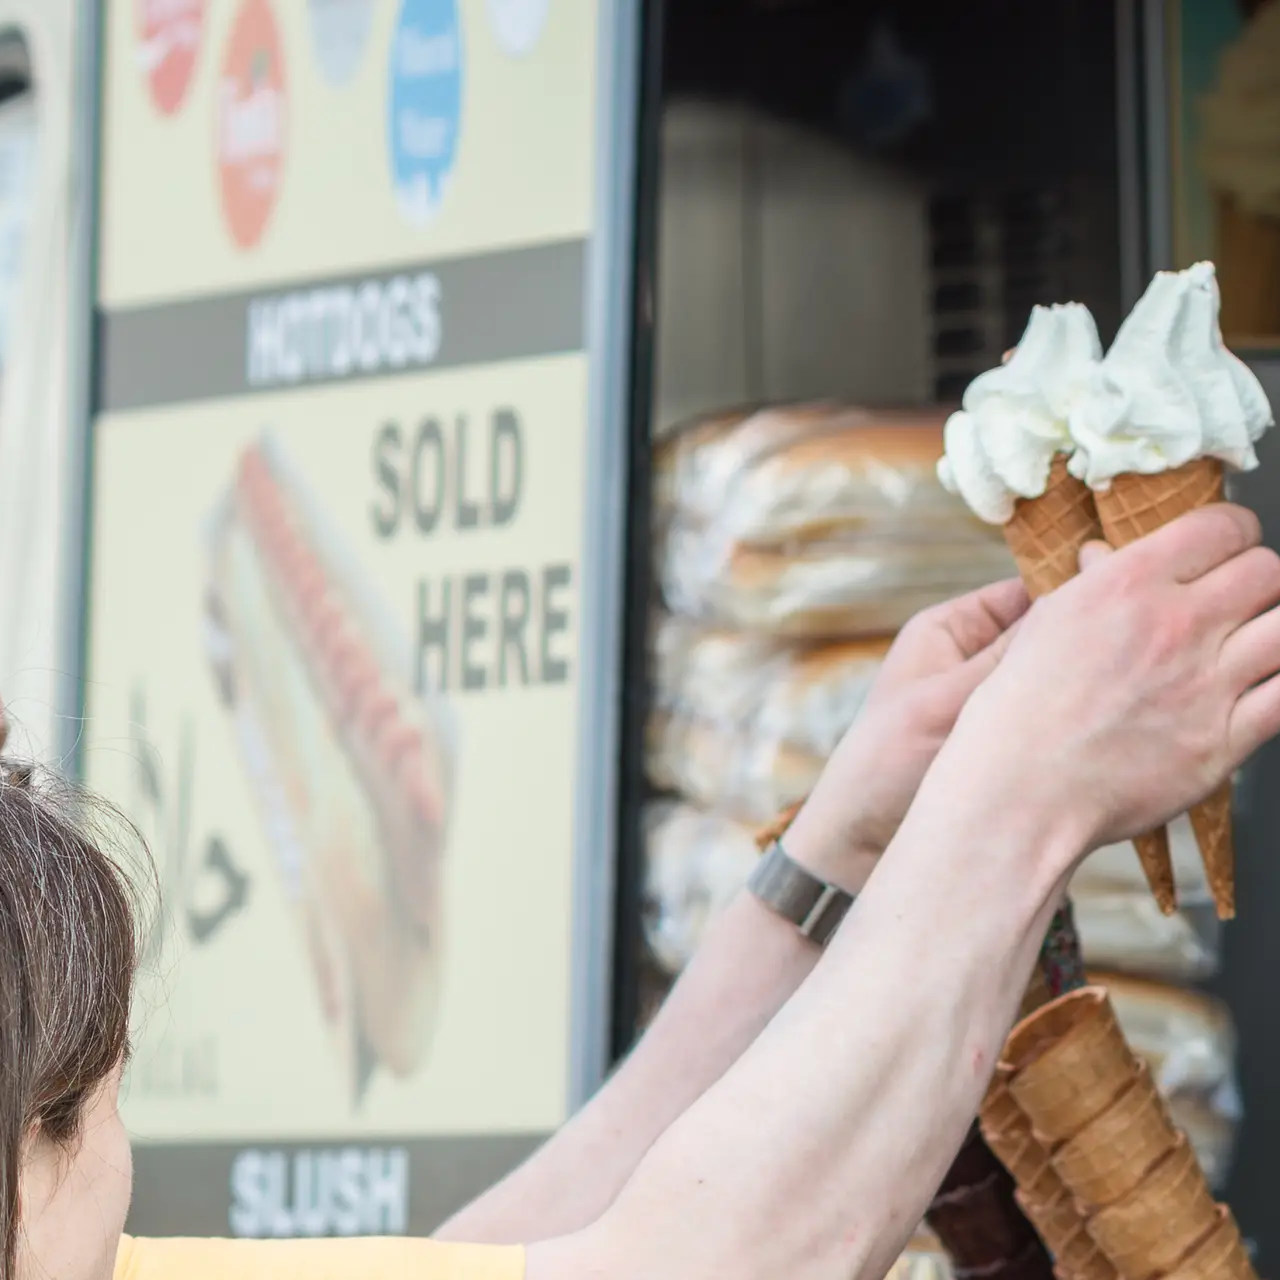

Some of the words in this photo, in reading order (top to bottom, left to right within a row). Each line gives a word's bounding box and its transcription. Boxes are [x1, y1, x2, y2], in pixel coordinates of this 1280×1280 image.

[371, 406, 524, 541] SOLD
[416, 561, 571, 695] HERE
[230, 1147, 408, 1237] SLUSH
